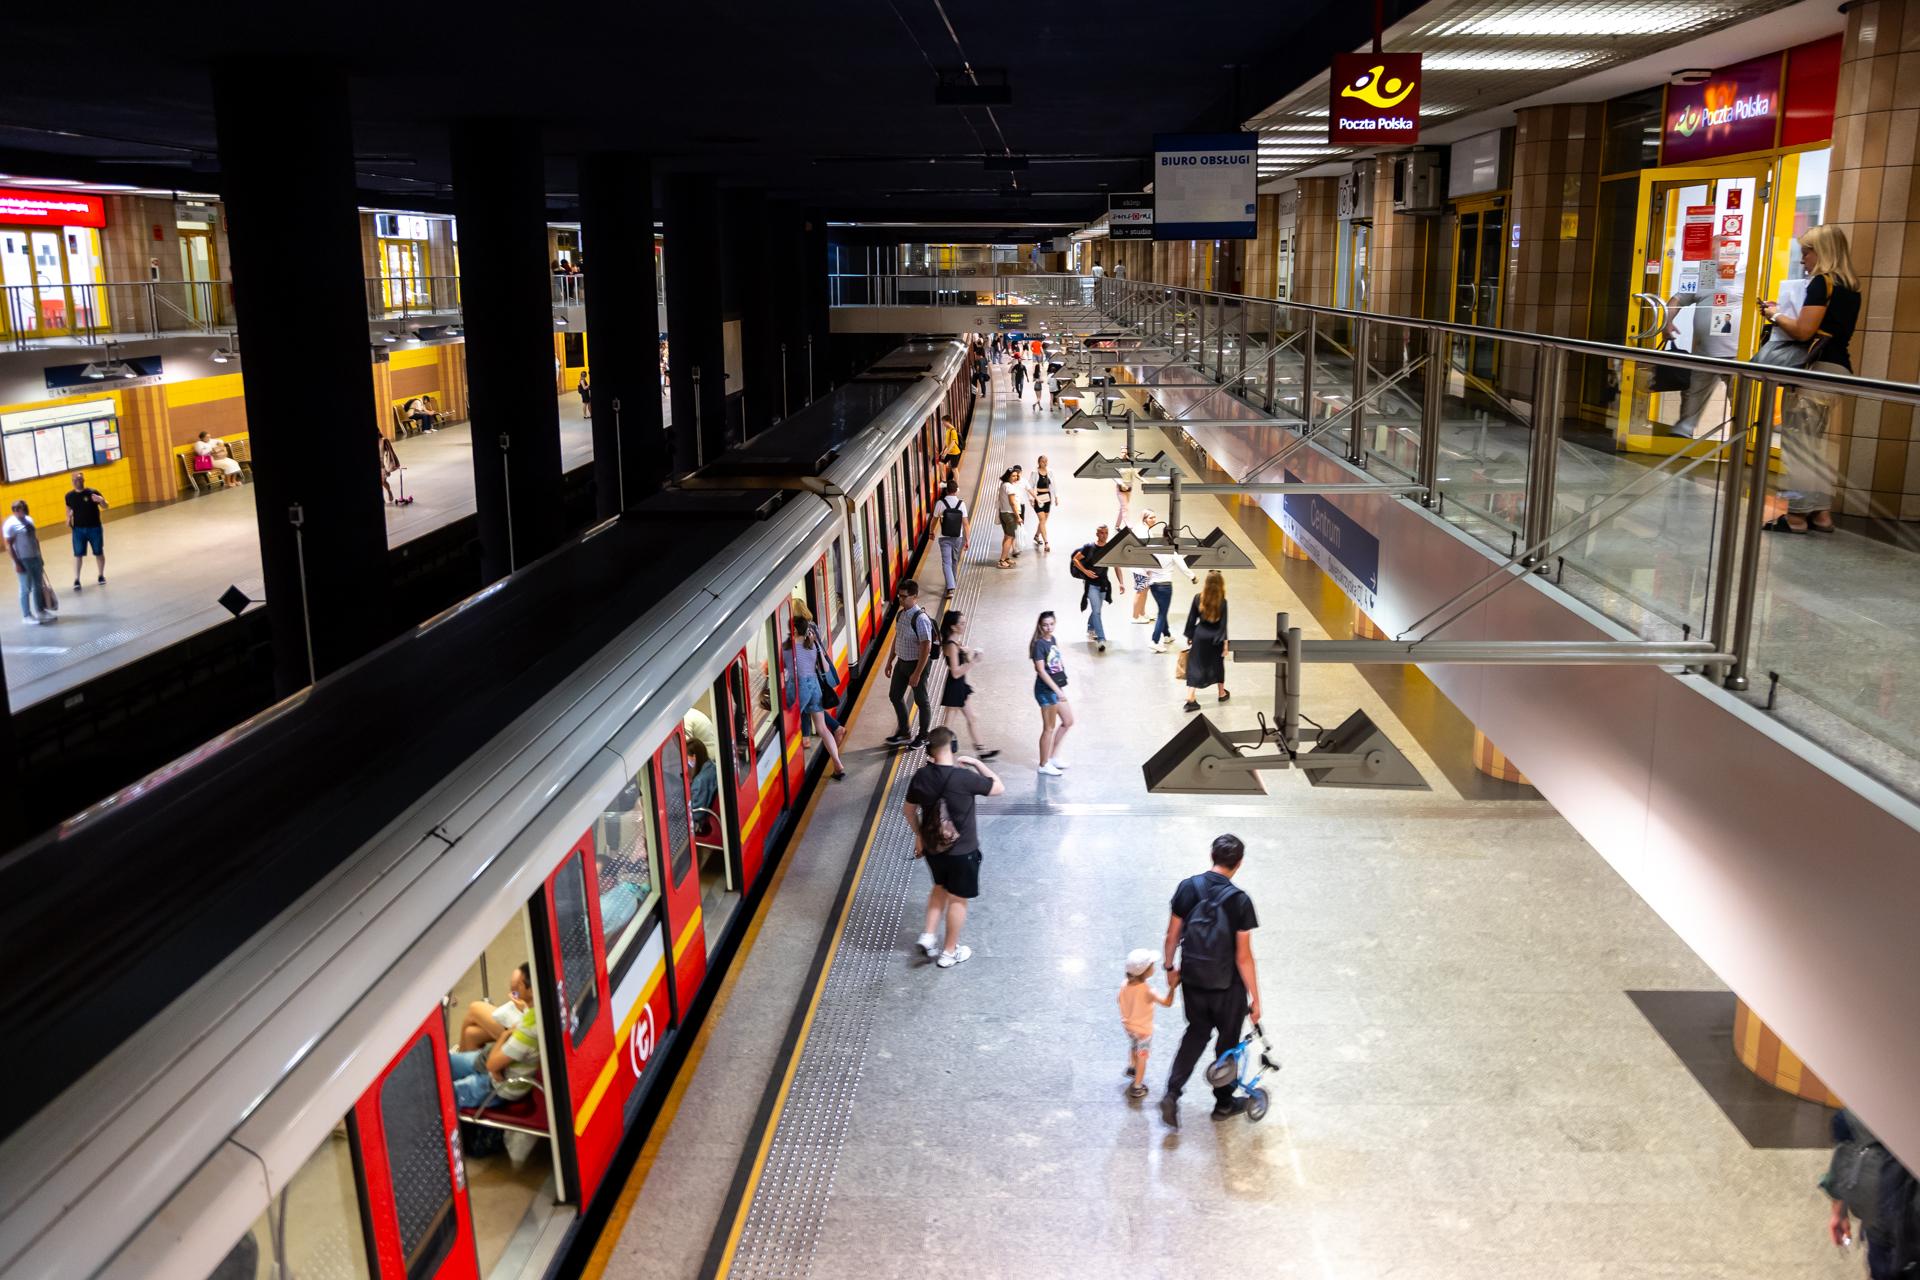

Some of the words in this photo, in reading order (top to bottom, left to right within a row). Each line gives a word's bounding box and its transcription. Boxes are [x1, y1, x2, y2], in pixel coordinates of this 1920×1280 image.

[1701, 106, 1734, 128] Poczta
[1735, 94, 1769, 121] Polska
[1339, 118, 1376, 130] Poczta
[1378, 117, 1413, 130] Polska
[1161, 156, 1197, 166] BIURO
[1200, 154, 1250, 165] OBSŁUGI
[1310, 498, 1341, 549] Centrum
